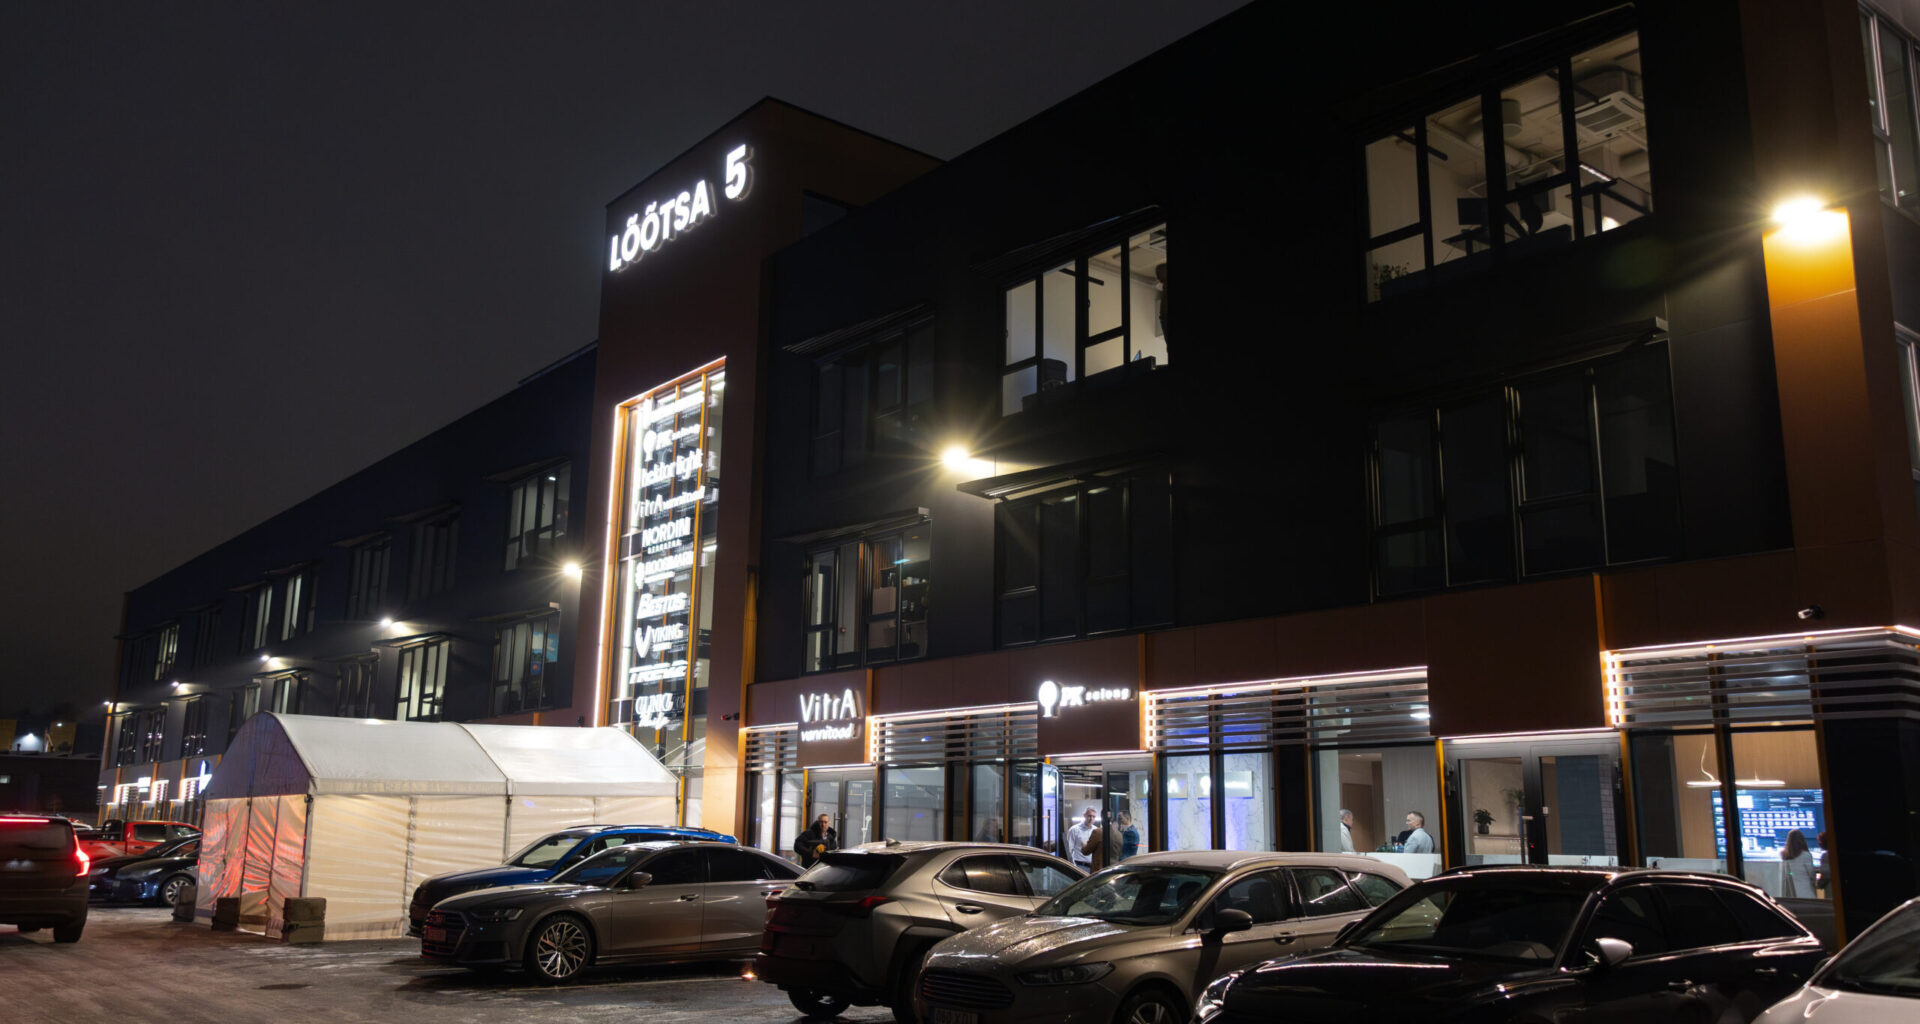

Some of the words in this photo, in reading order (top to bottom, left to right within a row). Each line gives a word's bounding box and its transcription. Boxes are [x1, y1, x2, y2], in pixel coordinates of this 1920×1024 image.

[609, 179, 711, 272] LÕÕTSA
[725, 143, 747, 200] 5
[651, 622, 684, 643] VIKING
[799, 688, 858, 723] VitrA
[1059, 685, 1086, 707] PK
